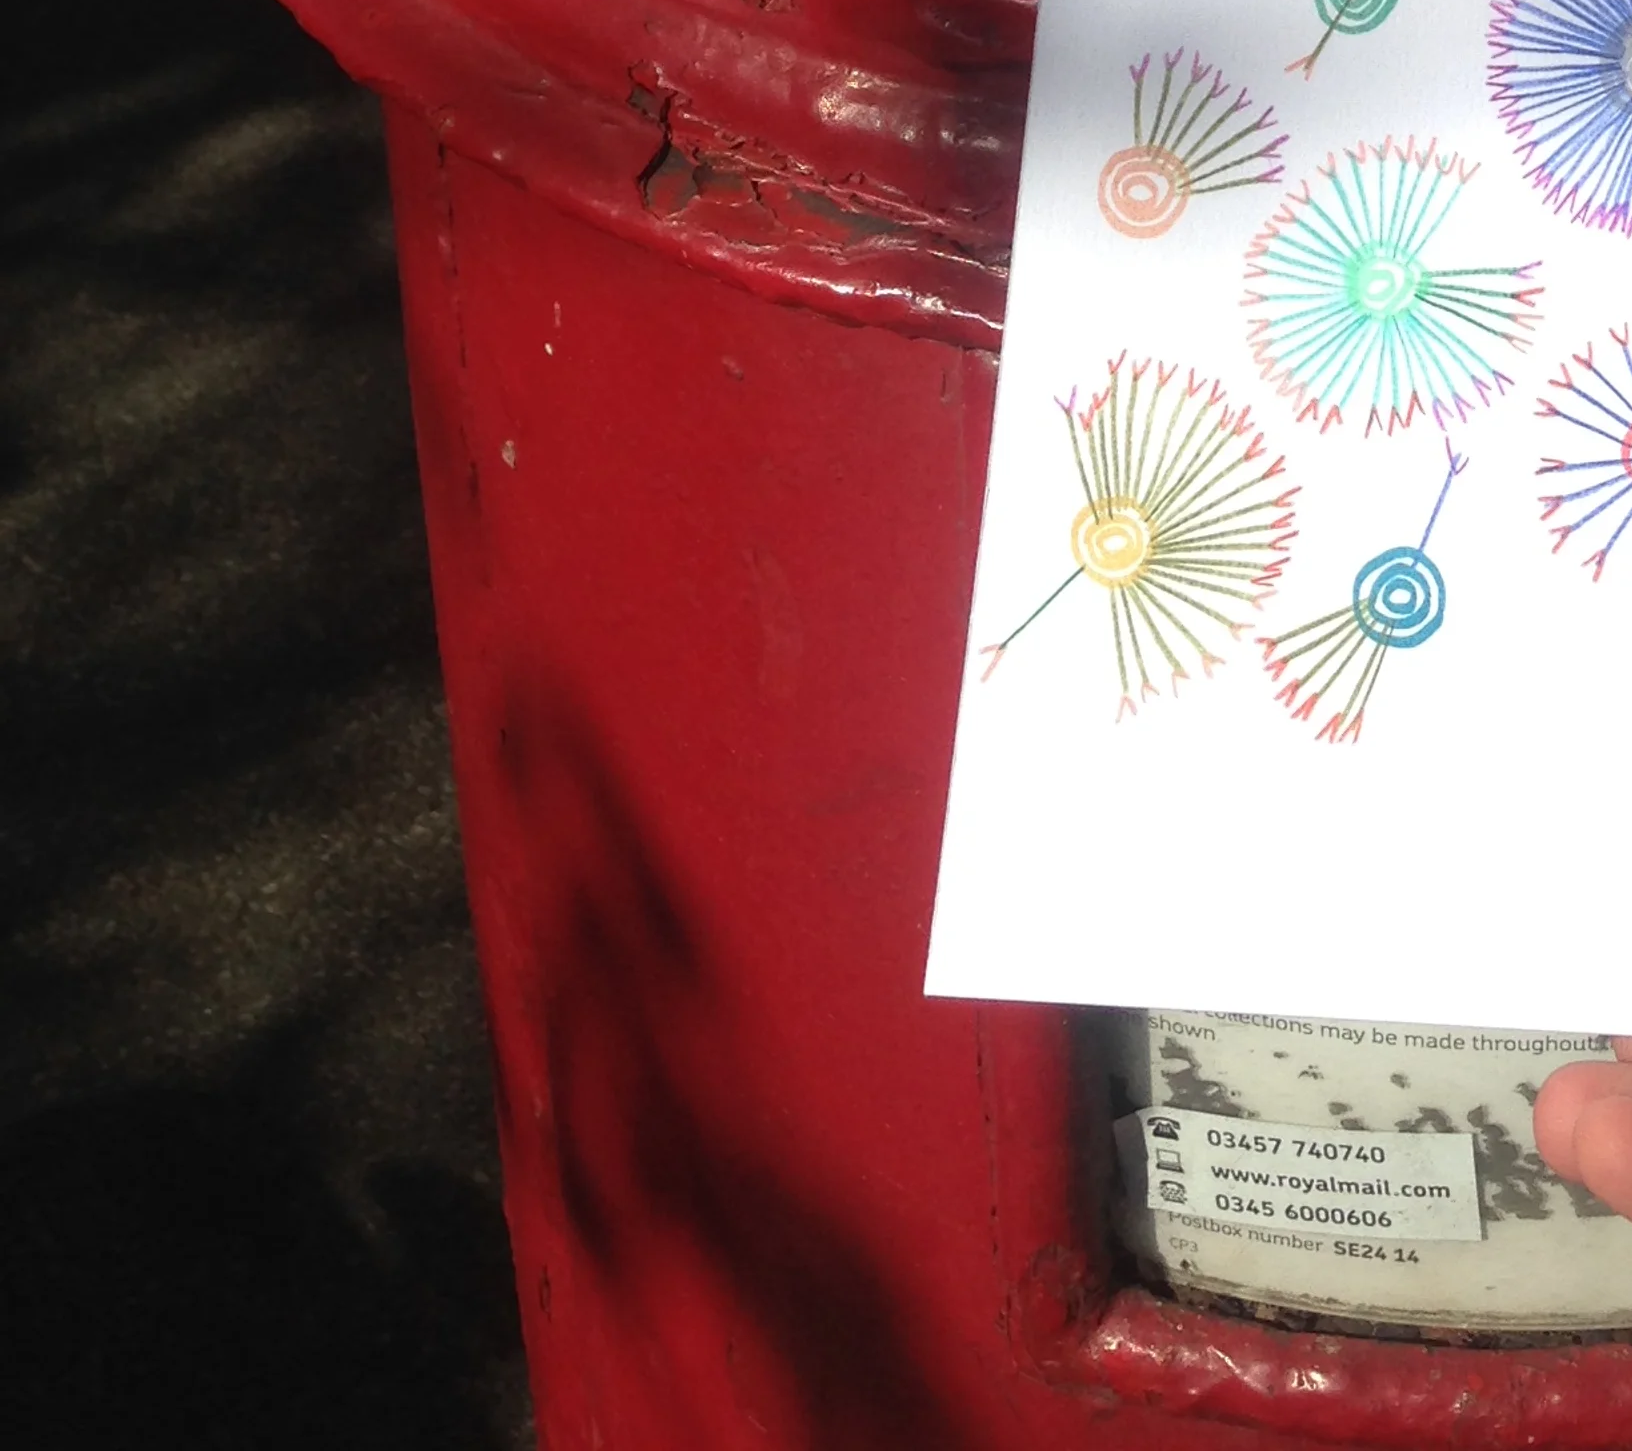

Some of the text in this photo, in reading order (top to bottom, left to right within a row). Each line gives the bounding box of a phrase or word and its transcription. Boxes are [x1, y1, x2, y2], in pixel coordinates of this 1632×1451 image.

[1148, 1015, 1216, 1041] shown
[1320, 1023, 1366, 1045] may
[1372, 1027, 1397, 1046] be
[1404, 1033, 1465, 1050] made
[1207, 1129, 1386, 1164] 03457 740740
[1211, 1164, 1451, 1199] www.royalmail.com
[1215, 1193, 1393, 1228] 0345 6000606
[1168, 1211, 1420, 1264] Postbox number SE24 14
